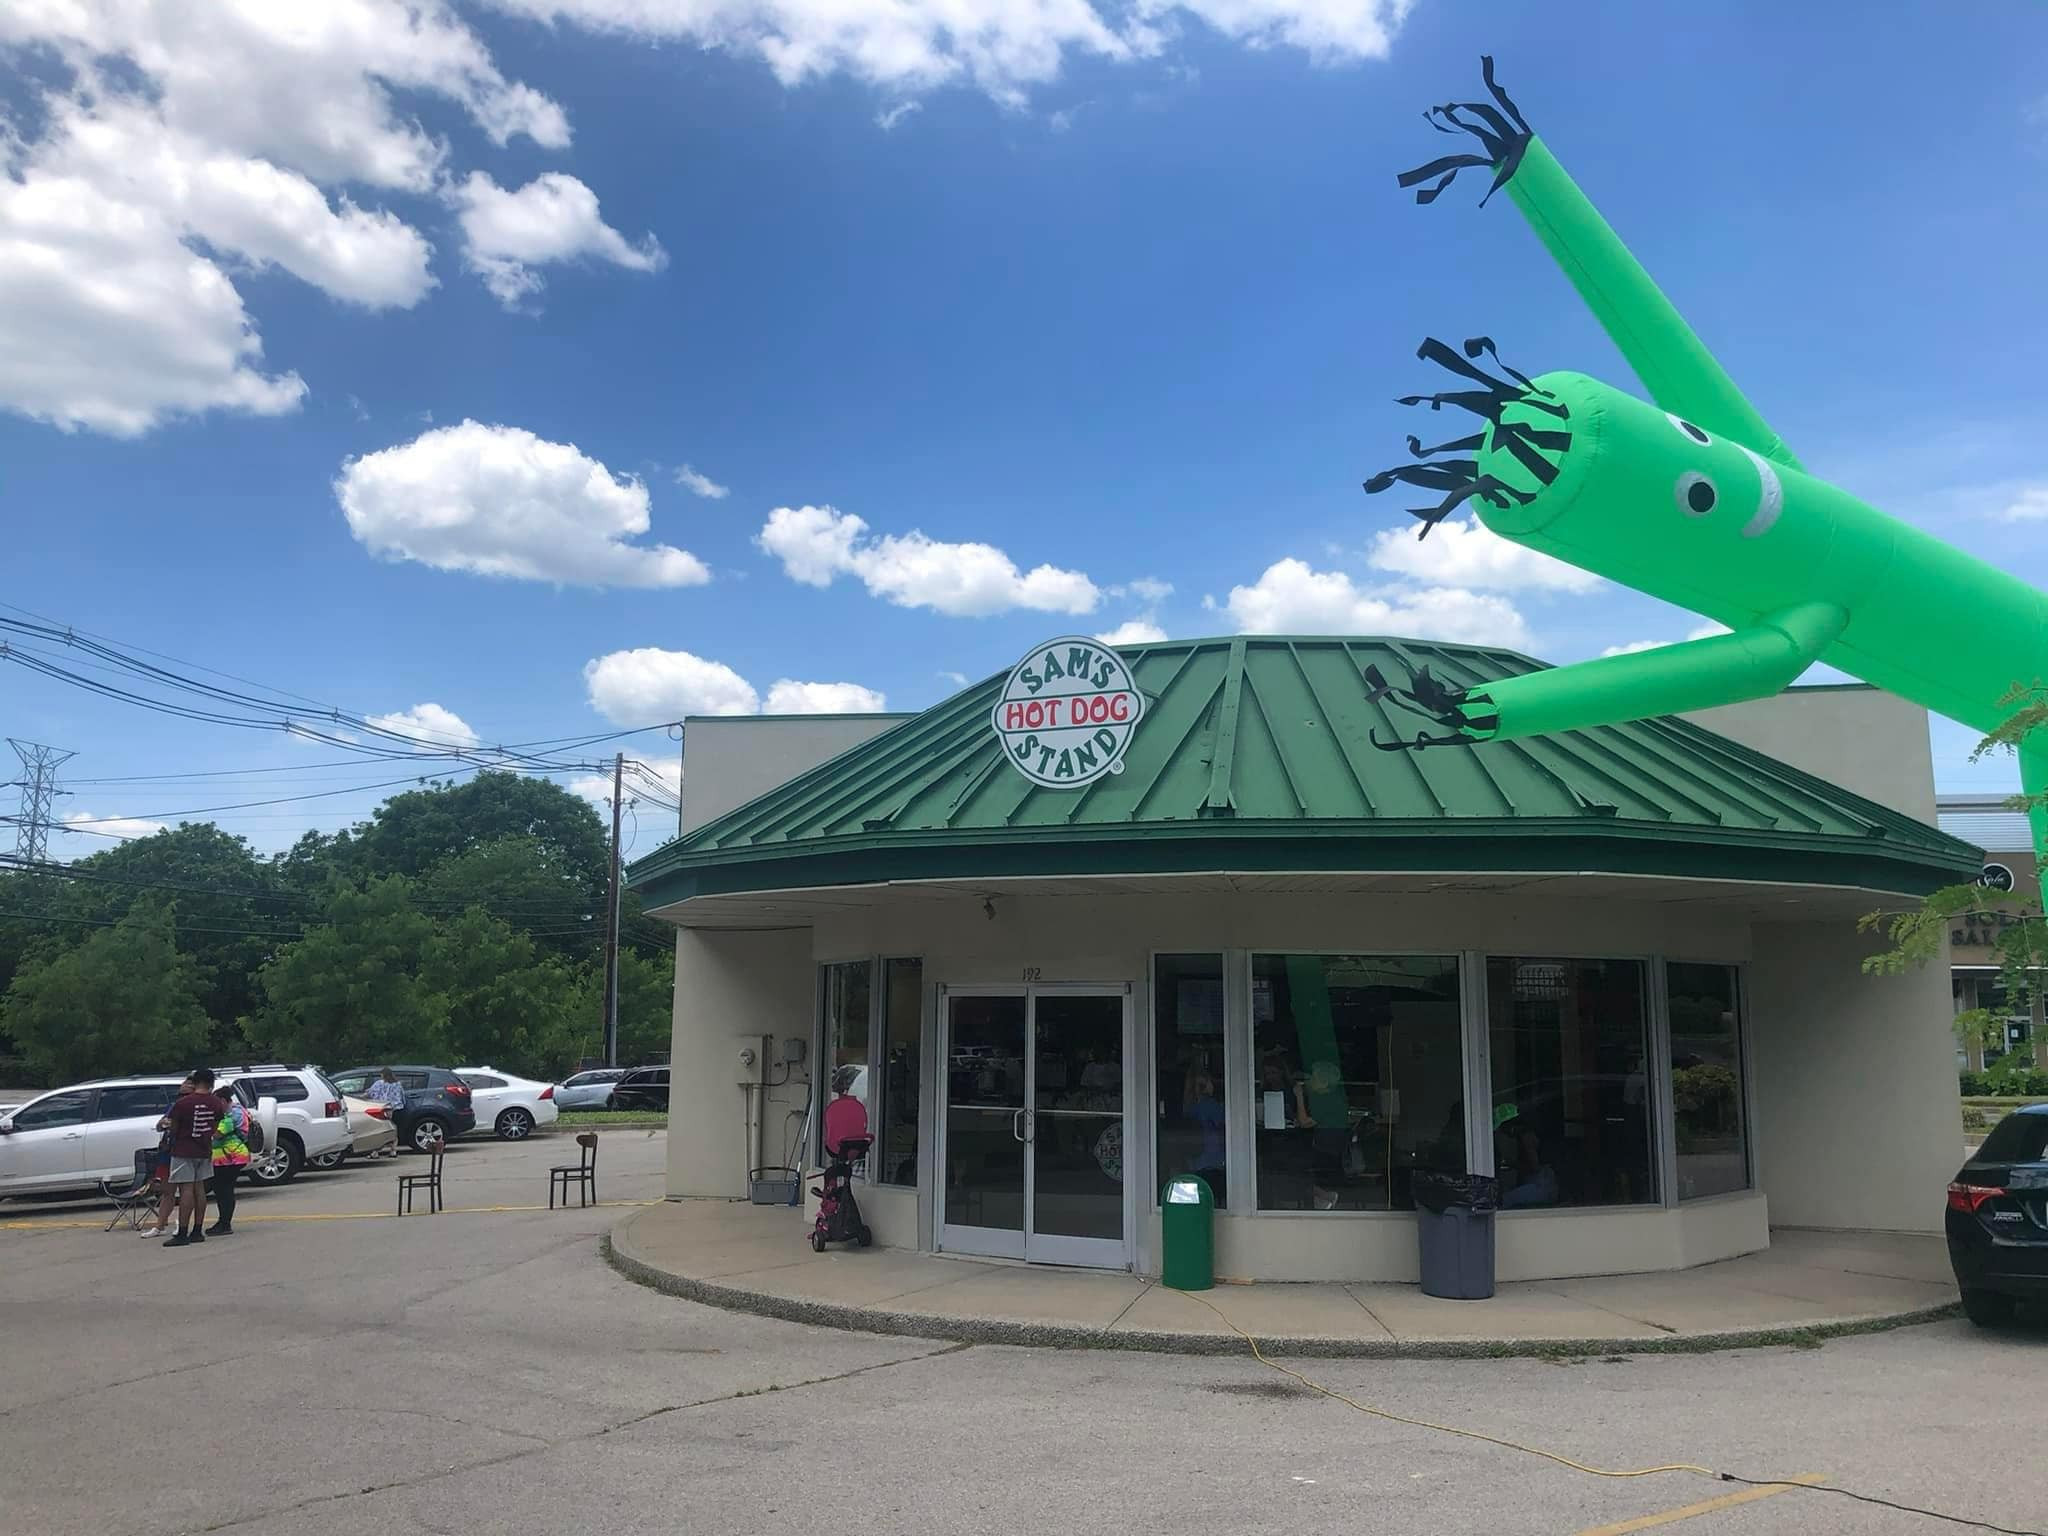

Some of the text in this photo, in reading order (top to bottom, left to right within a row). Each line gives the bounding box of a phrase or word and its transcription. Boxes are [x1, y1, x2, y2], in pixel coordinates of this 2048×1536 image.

[1020, 647, 1116, 695] SAM'S
[1006, 694, 1128, 729] HOT DOG
[1014, 728, 1117, 778] STAND
[1023, 967, 1041, 981] 192
